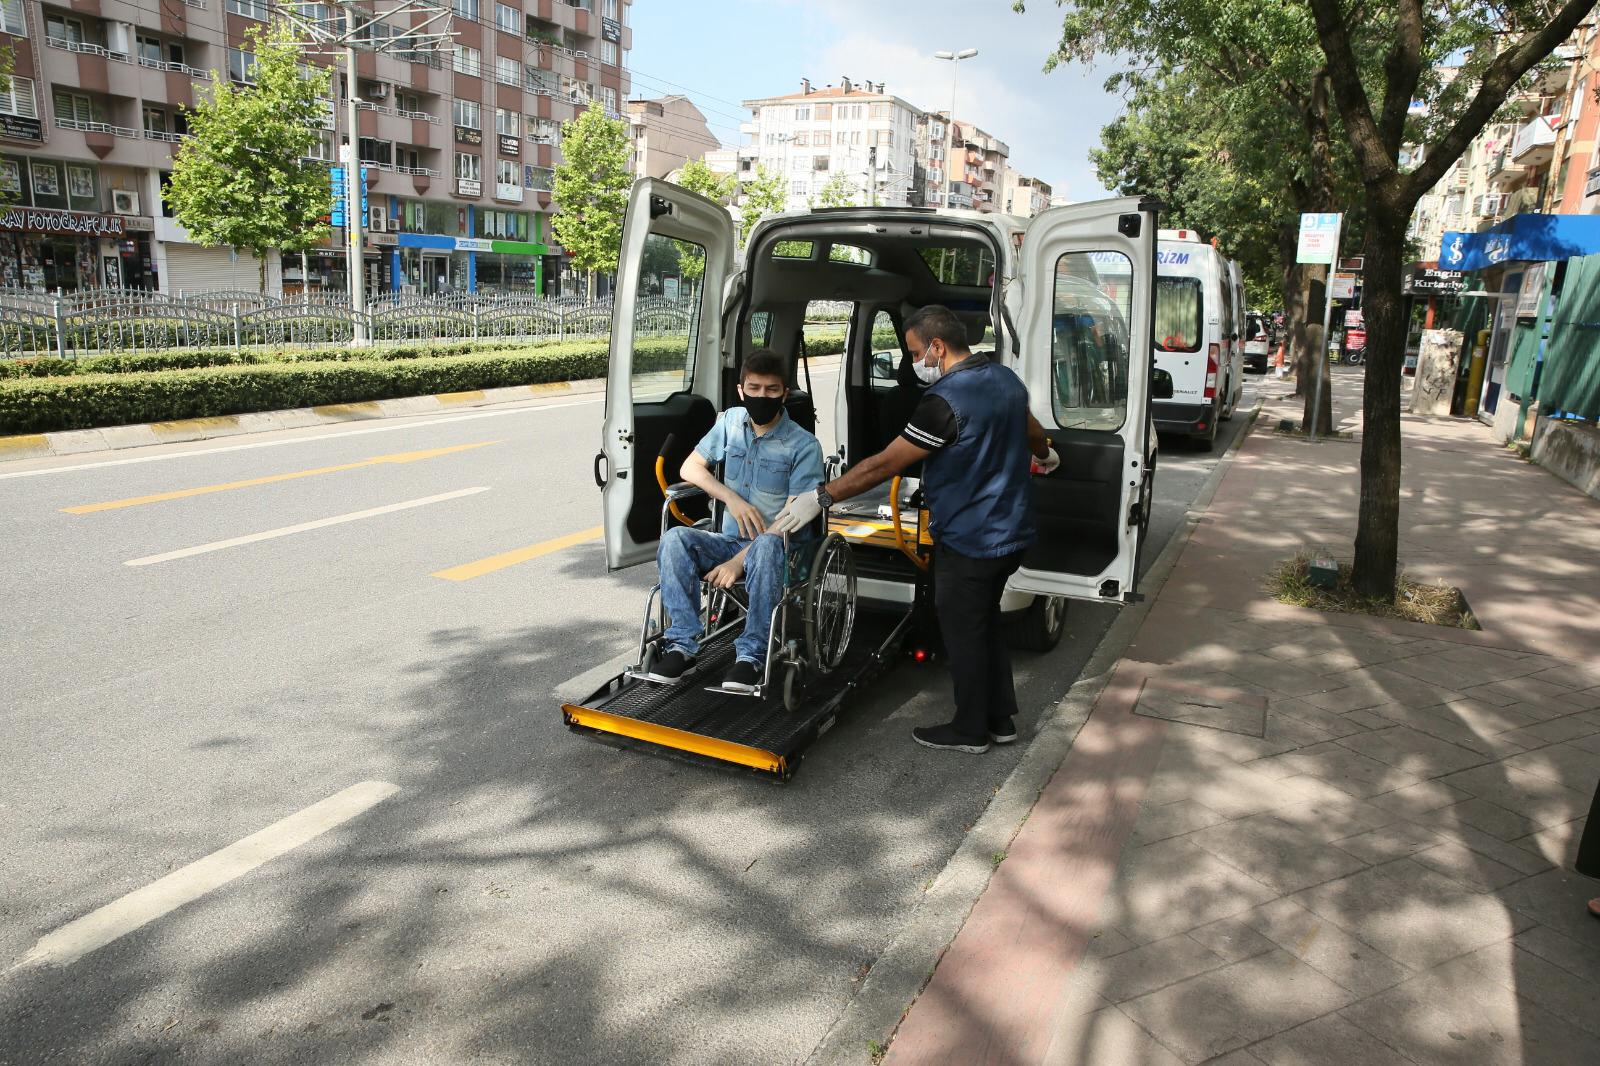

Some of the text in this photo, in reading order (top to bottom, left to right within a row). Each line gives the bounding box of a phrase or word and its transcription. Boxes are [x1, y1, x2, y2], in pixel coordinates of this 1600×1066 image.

[27, 211, 122, 235] FOTOĞRAFÇILIK
[1424, 268, 1462, 280] Engin
[1414, 279, 1469, 290] Kırtasiye
